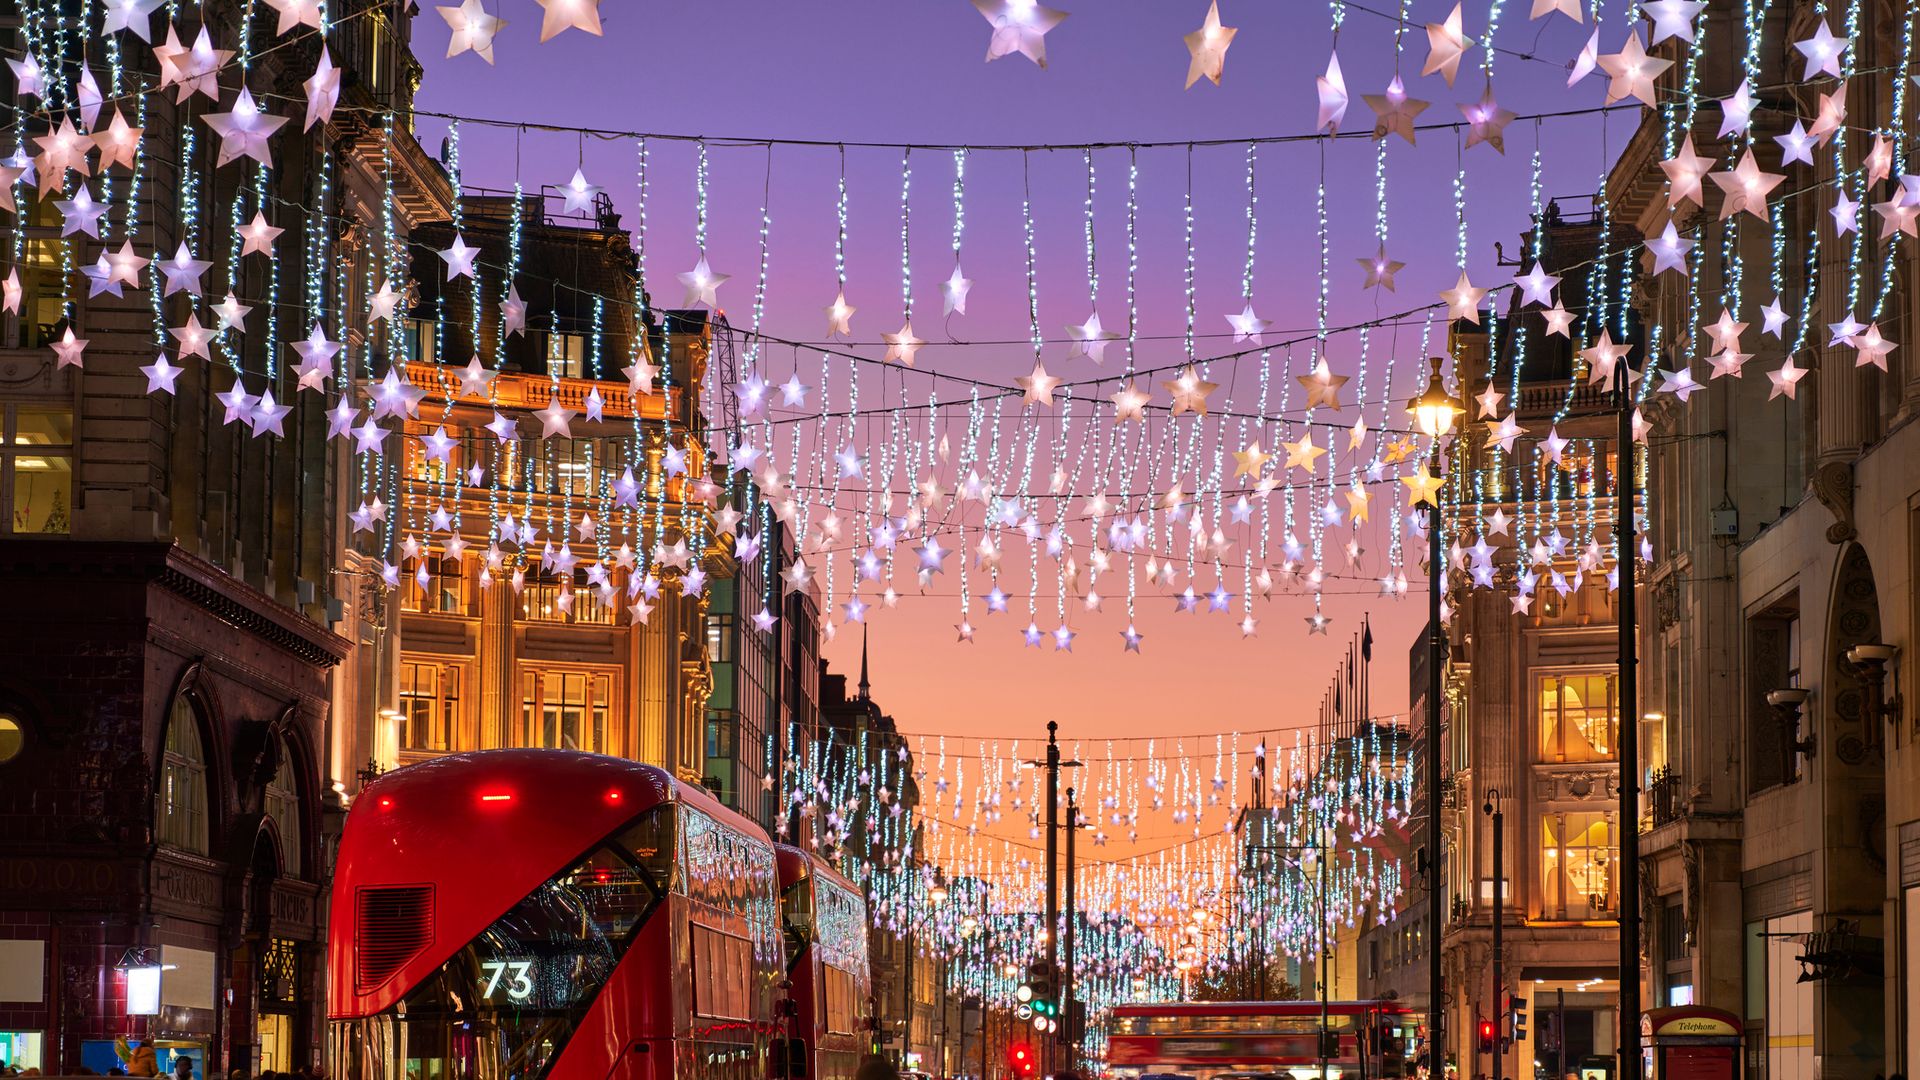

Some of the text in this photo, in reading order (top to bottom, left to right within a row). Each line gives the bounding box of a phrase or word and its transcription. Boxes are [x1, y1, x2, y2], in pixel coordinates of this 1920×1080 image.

[167, 867, 213, 905] OXFORD
[482, 961, 531, 999] 73
[1678, 1022, 1717, 1031] Telephone
